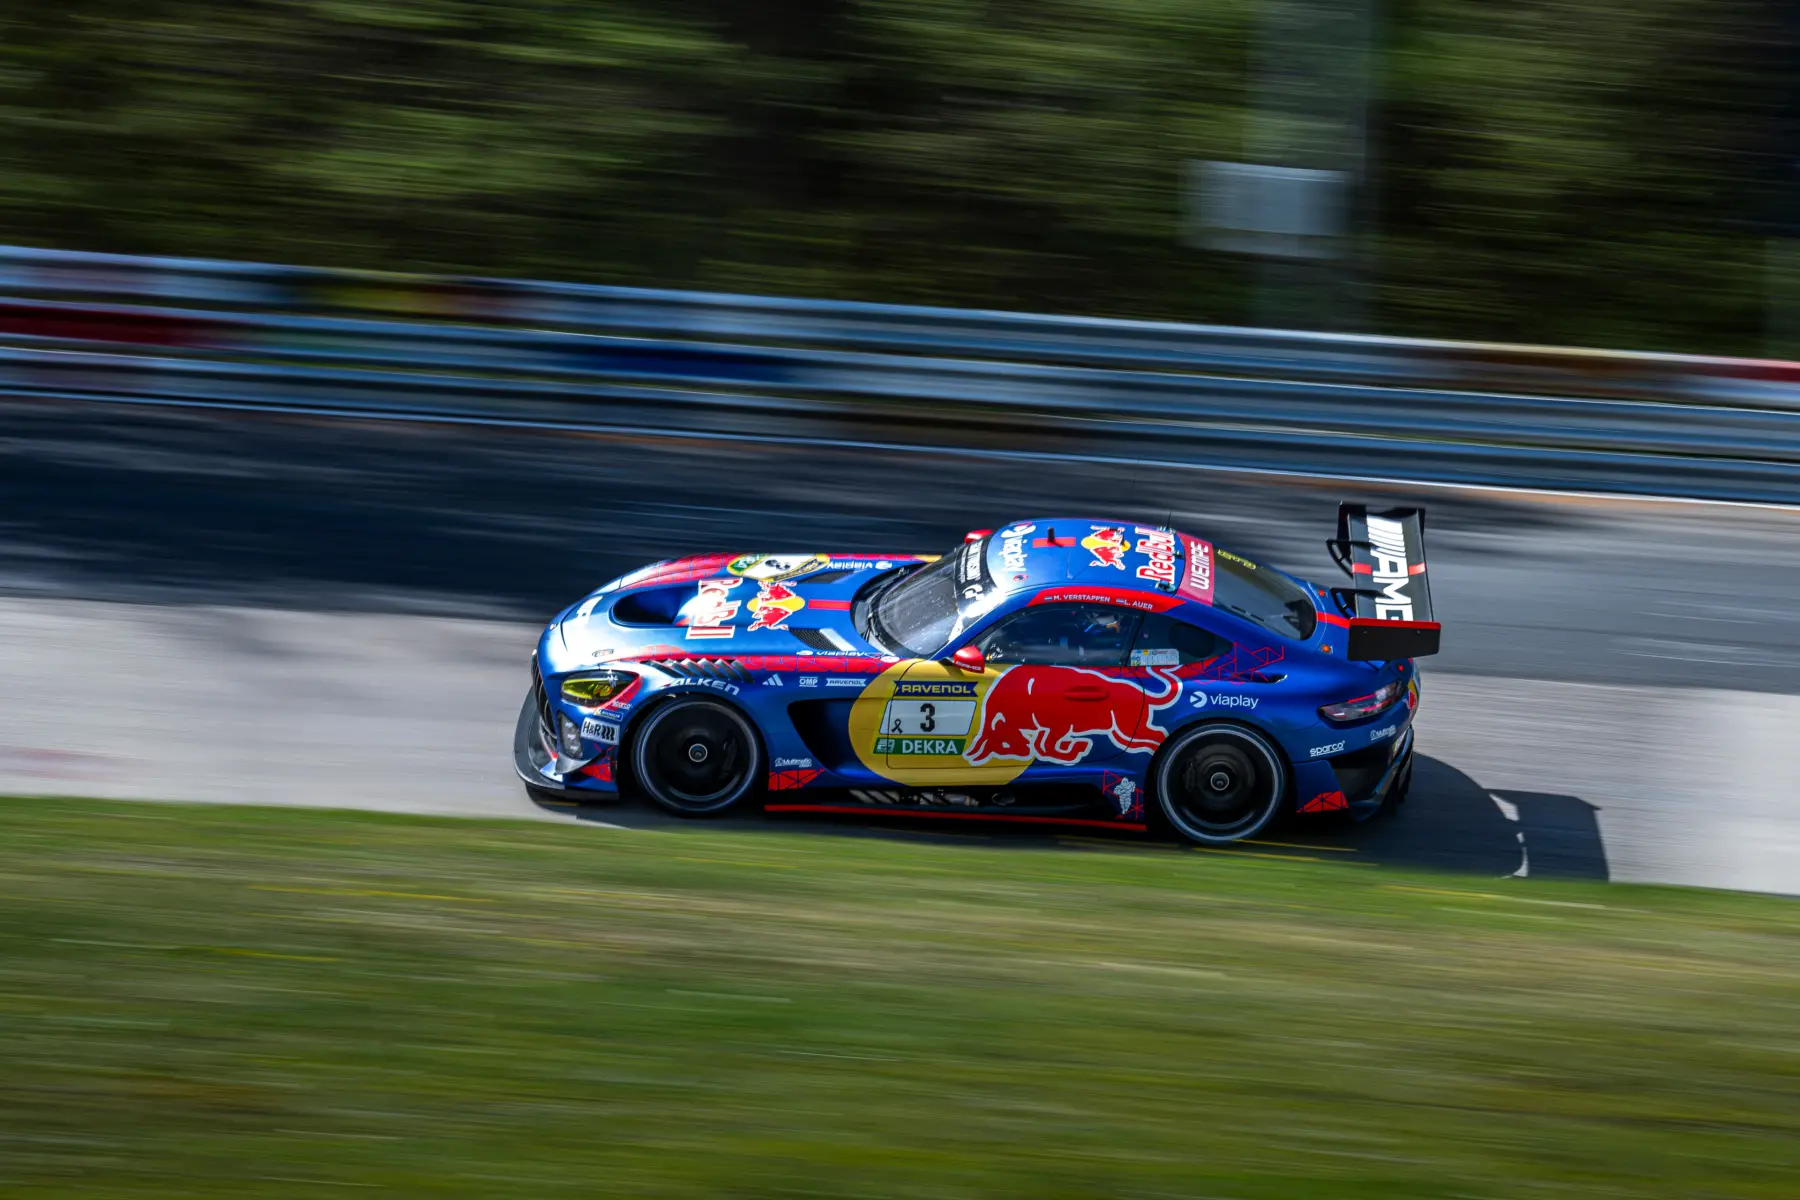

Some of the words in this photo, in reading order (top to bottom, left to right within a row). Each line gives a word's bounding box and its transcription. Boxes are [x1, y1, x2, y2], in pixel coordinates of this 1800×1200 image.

[1190, 541, 1210, 590] WEMPE
[1063, 594, 1111, 603] VERSTAPPEN
[1133, 601, 1153, 610] AUER
[665, 677, 741, 696] ALKEN
[901, 684, 971, 694] RAVENOL
[1210, 693, 1259, 709] viaplay
[920, 703, 936, 732] 3
[582, 720, 601, 736] H&R
[902, 740, 958, 754] DEKRA
[1309, 742, 1344, 757] sparco
